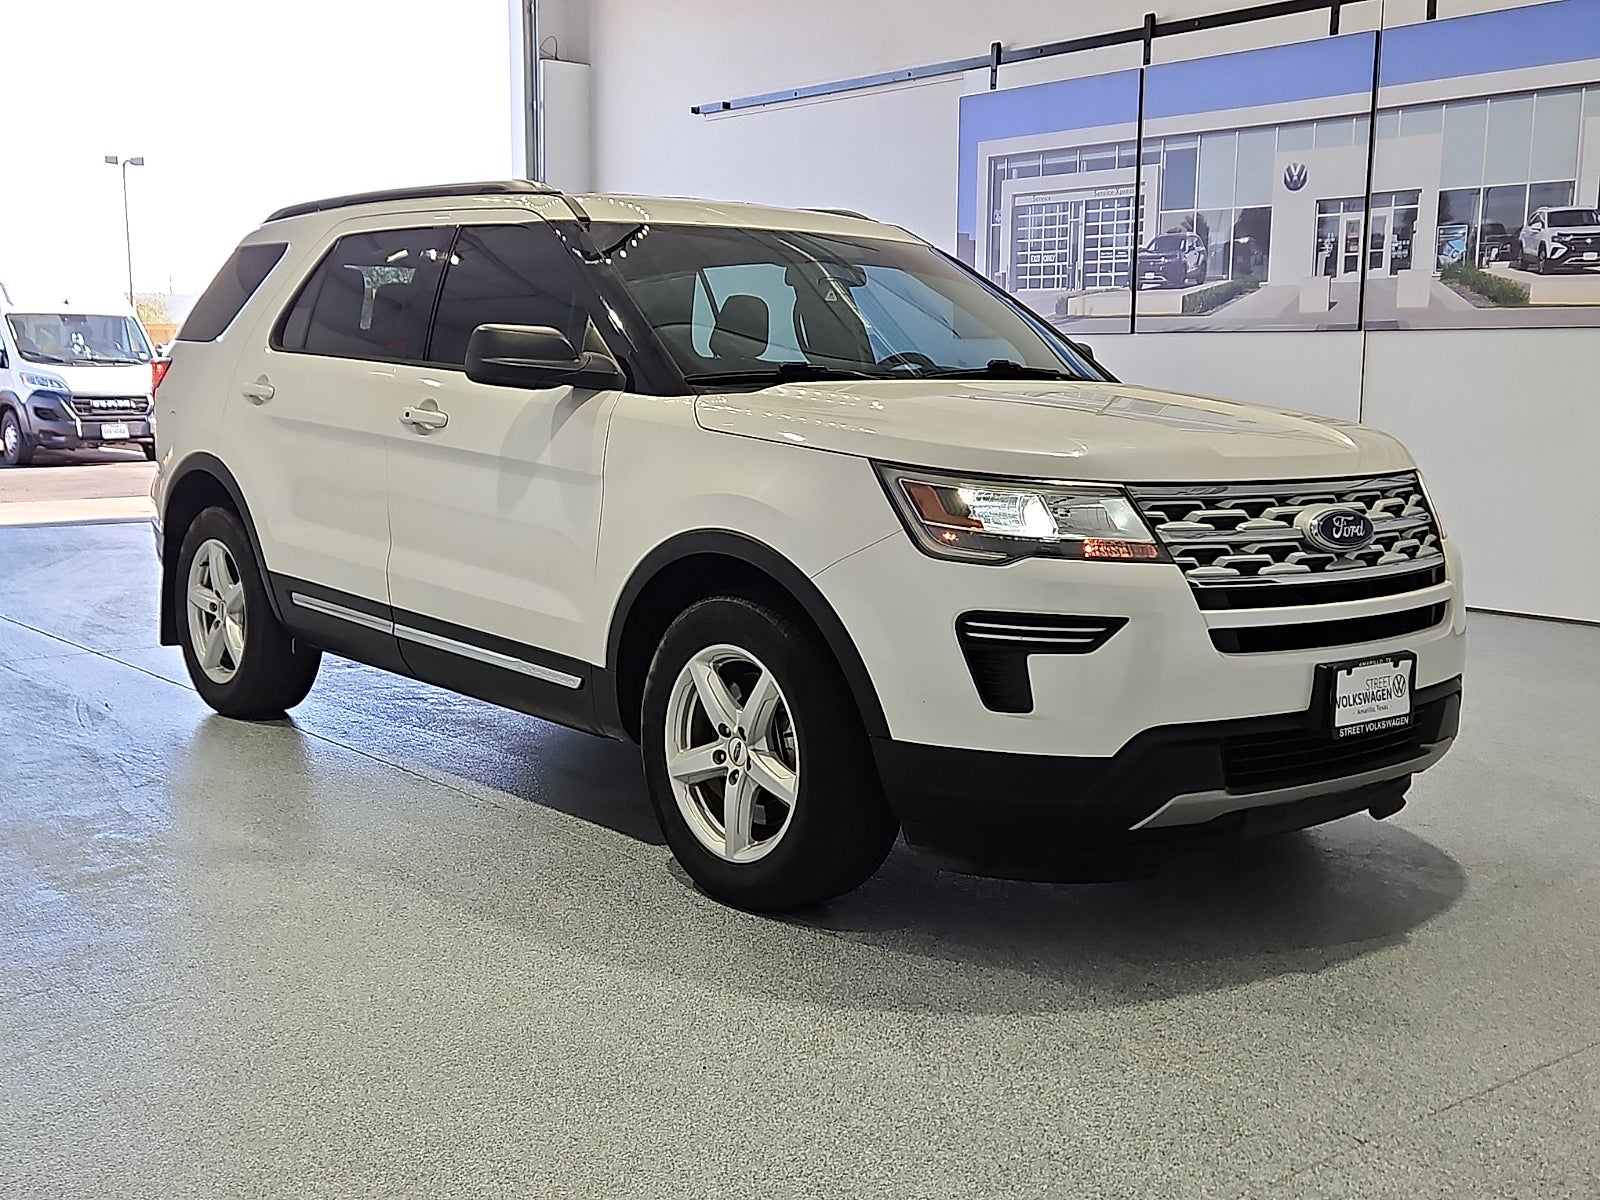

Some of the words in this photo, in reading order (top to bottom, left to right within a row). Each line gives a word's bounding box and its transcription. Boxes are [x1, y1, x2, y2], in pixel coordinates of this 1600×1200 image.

[1093, 189, 1114, 197] Service
[1332, 516, 1366, 539] Ford
[1365, 675, 1392, 691] STREET
[1336, 687, 1393, 709] VOLKSWAGEN
[1339, 724, 1364, 738] STREET
[1364, 716, 1409, 733] VOLKSWAGEN
